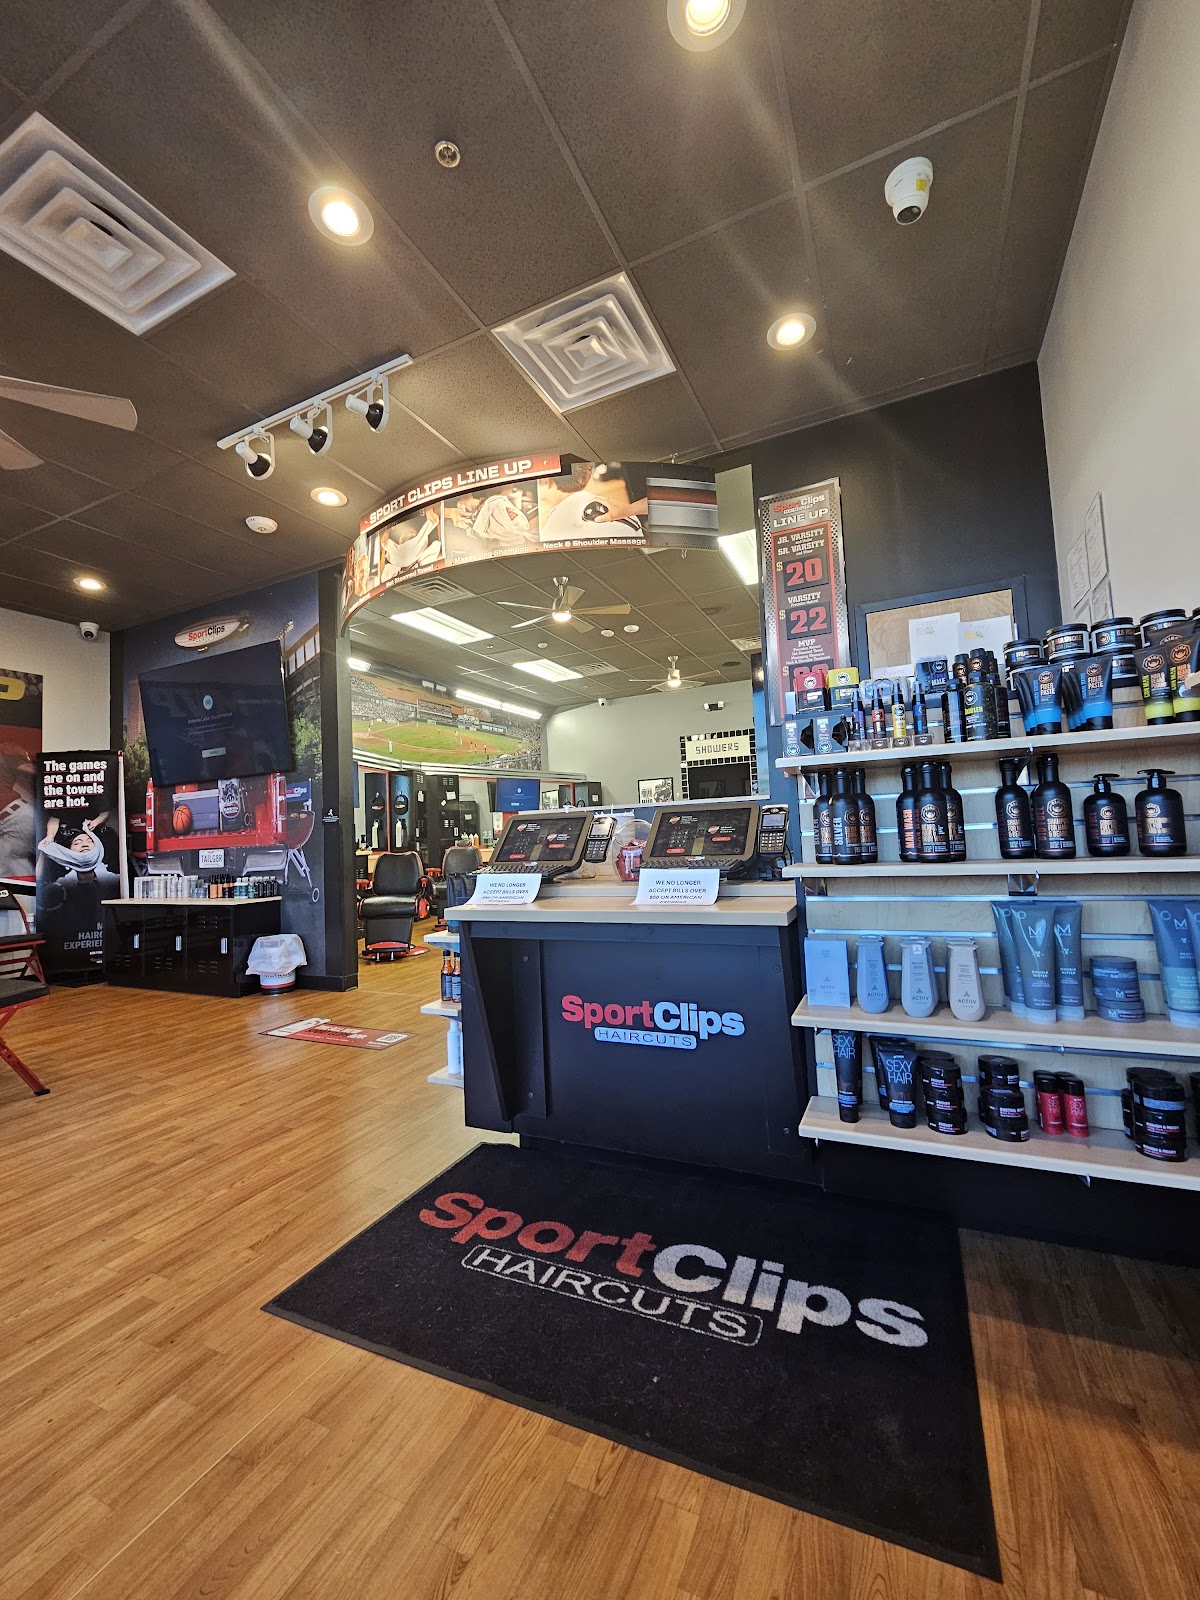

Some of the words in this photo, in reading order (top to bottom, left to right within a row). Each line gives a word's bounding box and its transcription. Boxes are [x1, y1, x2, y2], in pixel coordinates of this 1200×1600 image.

[369, 495, 406, 524] SPORT
[407, 476, 454, 503] CLIPS
[457, 465, 500, 486] LINE
[504, 459, 532, 475] UP
[773, 513, 805, 528] LINE
[808, 508, 829, 519] UP
[572, 538, 609, 547] Shoulder
[609, 538, 646, 546] Massage
[777, 536, 790, 545] JR.
[790, 528, 824, 541] VARSITY
[493, 546, 530, 557] Shampoo
[777, 547, 790, 556] SR.
[791, 539, 825, 553] VARSITY
[776, 561, 783, 572] $
[786, 557, 823, 586] 20
[788, 591, 822, 604] VARSITY
[779, 609, 786, 620] $
[790, 606, 828, 634] 22
[188, 625, 225, 641] SportClips
[797, 639, 816, 648] MVP
[783, 666, 789, 676] $
[931, 677, 946, 687] MALE
[1040, 682, 1054, 690] FIBER
[1088, 680, 1104, 689] PASTE
[1040, 688, 1056, 696] PASTE
[695, 742, 740, 754] SHOWERS
[43, 760, 67, 772] The
[68, 760, 108, 773] games
[43, 774, 64, 784] are
[65, 773, 81, 783] on
[82, 770, 105, 782] and
[43, 784, 64, 796] the
[65, 782, 104, 795] towels
[43, 798, 64, 809] are
[66, 795, 90, 807] hot.
[902, 809, 914, 830] WASH
[833, 817, 843, 846] SILVER
[904, 831, 915, 849] MAN
[561, 995, 745, 1039] SportClips
[598, 1028, 692, 1047] HAIRCUTS
[832, 1034, 857, 1048] SEXY
[833, 1046, 856, 1059] HAIR
[886, 1059, 913, 1072] SEXY
[887, 1072, 913, 1085] HAIR
[419, 1191, 929, 1347] SportClips
[472, 1247, 749, 1340] HAIRCUTS
